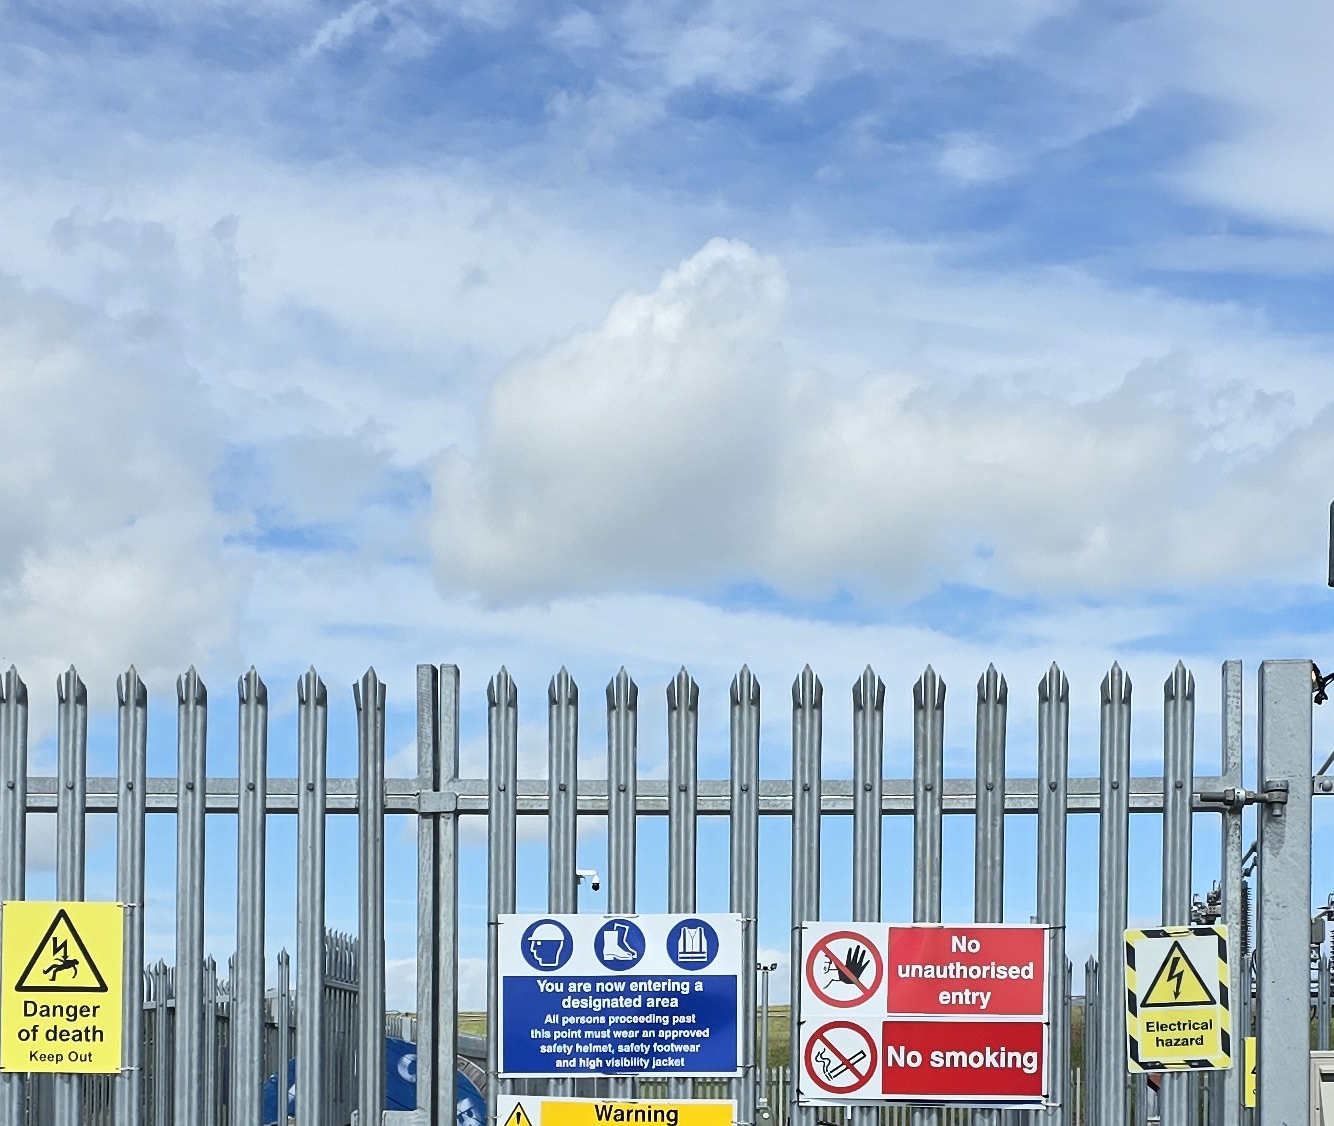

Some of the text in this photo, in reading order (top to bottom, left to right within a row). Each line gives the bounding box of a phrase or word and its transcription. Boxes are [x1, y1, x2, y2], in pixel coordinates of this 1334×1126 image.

[951, 935, 981, 953] No
[897, 961, 1034, 980] unauthorised
[536, 978, 704, 995] You are now entering a
[561, 994, 679, 1012] designated area
[938, 988, 992, 1010] entry
[23, 1000, 101, 1023] Danger
[544, 1013, 696, 1027] All persons proceeding past
[17, 1024, 104, 1043] of death
[530, 1027, 710, 1041] this point must wear an approved
[1145, 1018, 1214, 1034] Electrical
[539, 1042, 701, 1056] safety helmet, safety footwear
[1155, 1034, 1205, 1048] hazard
[29, 1050, 93, 1065] Keep Out
[555, 1056, 685, 1070] and high visibility jacket
[887, 1045, 1038, 1074] No smoking
[594, 1104, 680, 1126] Warning
